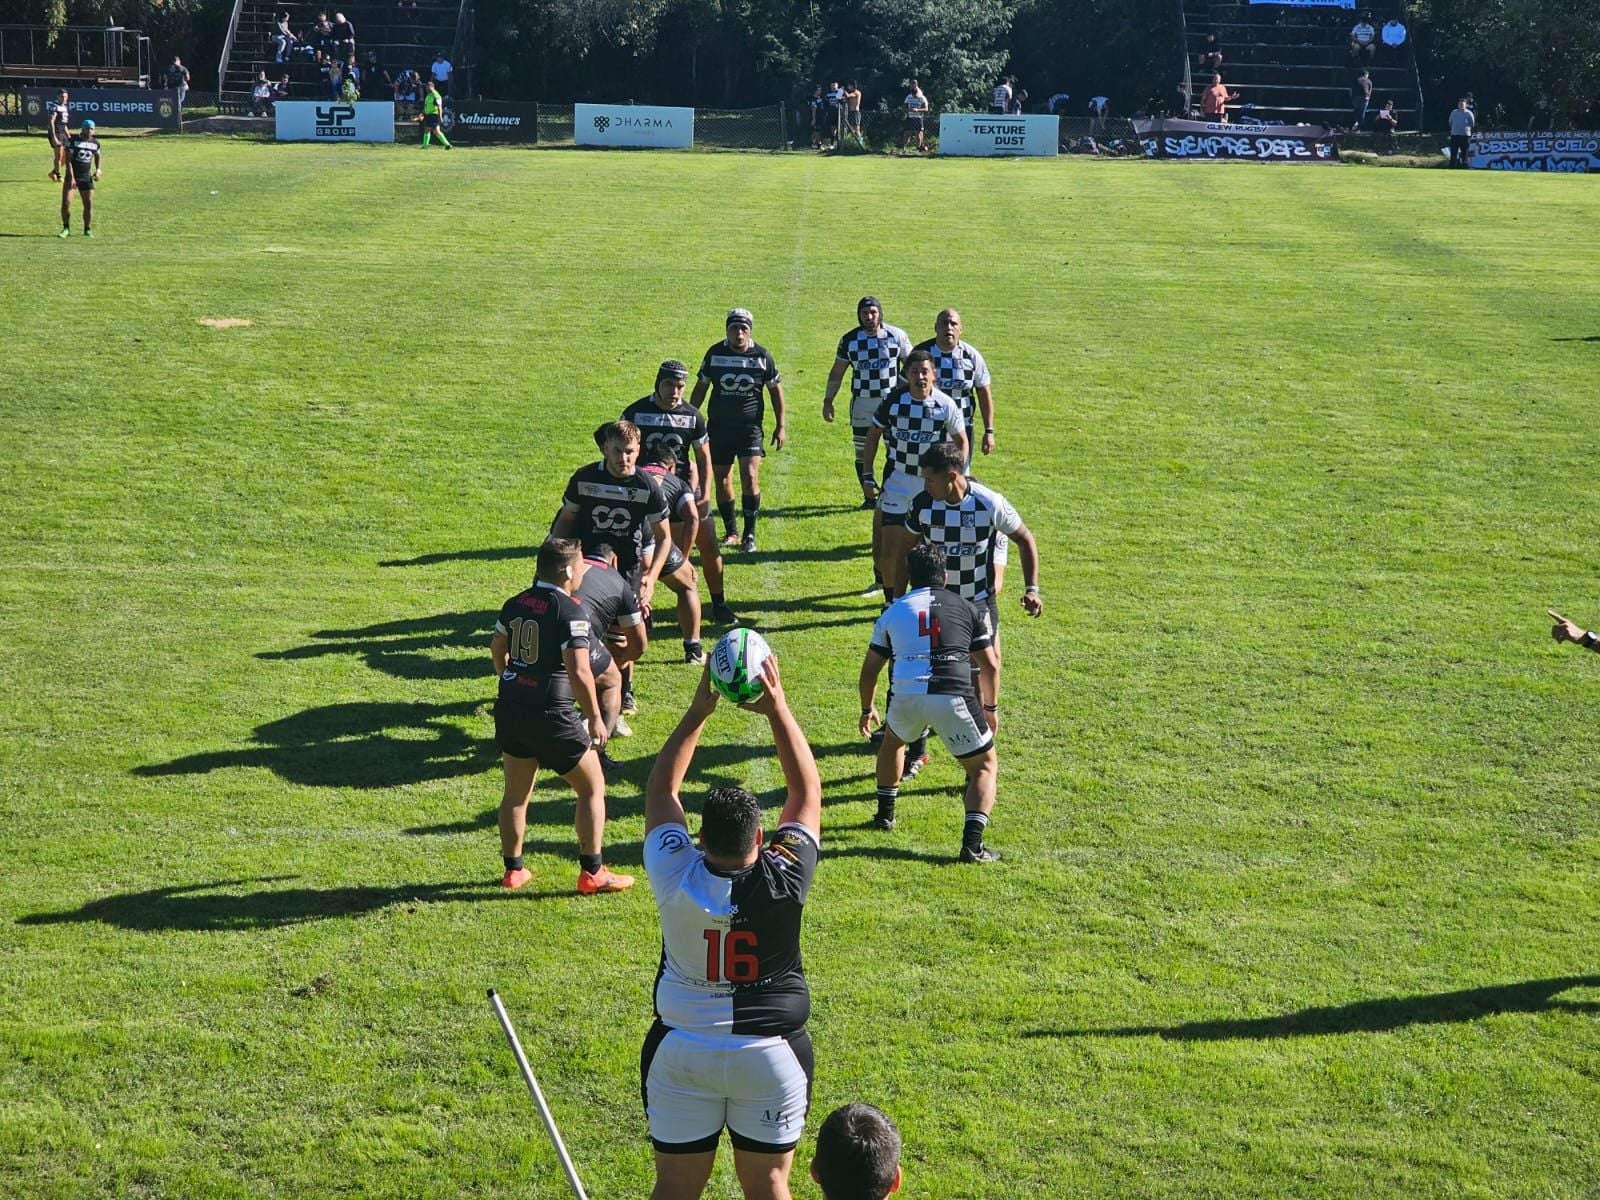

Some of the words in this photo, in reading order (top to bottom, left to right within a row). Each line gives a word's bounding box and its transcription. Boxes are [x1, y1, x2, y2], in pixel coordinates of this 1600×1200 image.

[46, 102, 99, 112] RPETO
[103, 102, 153, 113] SIEMPRE
[459, 112, 520, 125] Sabañones
[615, 117, 672, 128] DHARMA
[973, 125, 1026, 135] TEXTURE
[1207, 123, 1232, 131] GLEW
[995, 136, 1026, 145] DUST
[1165, 135, 1256, 156] SIEMPRE
[1479, 140, 1529, 153] DESDE
[1532, 140, 1550, 151] EL
[1555, 140, 1598, 152] CIELO
[938, 543, 981, 556] ndar
[918, 610, 941, 651] 4
[509, 616, 540, 665] 19
[703, 928, 759, 983] 16
